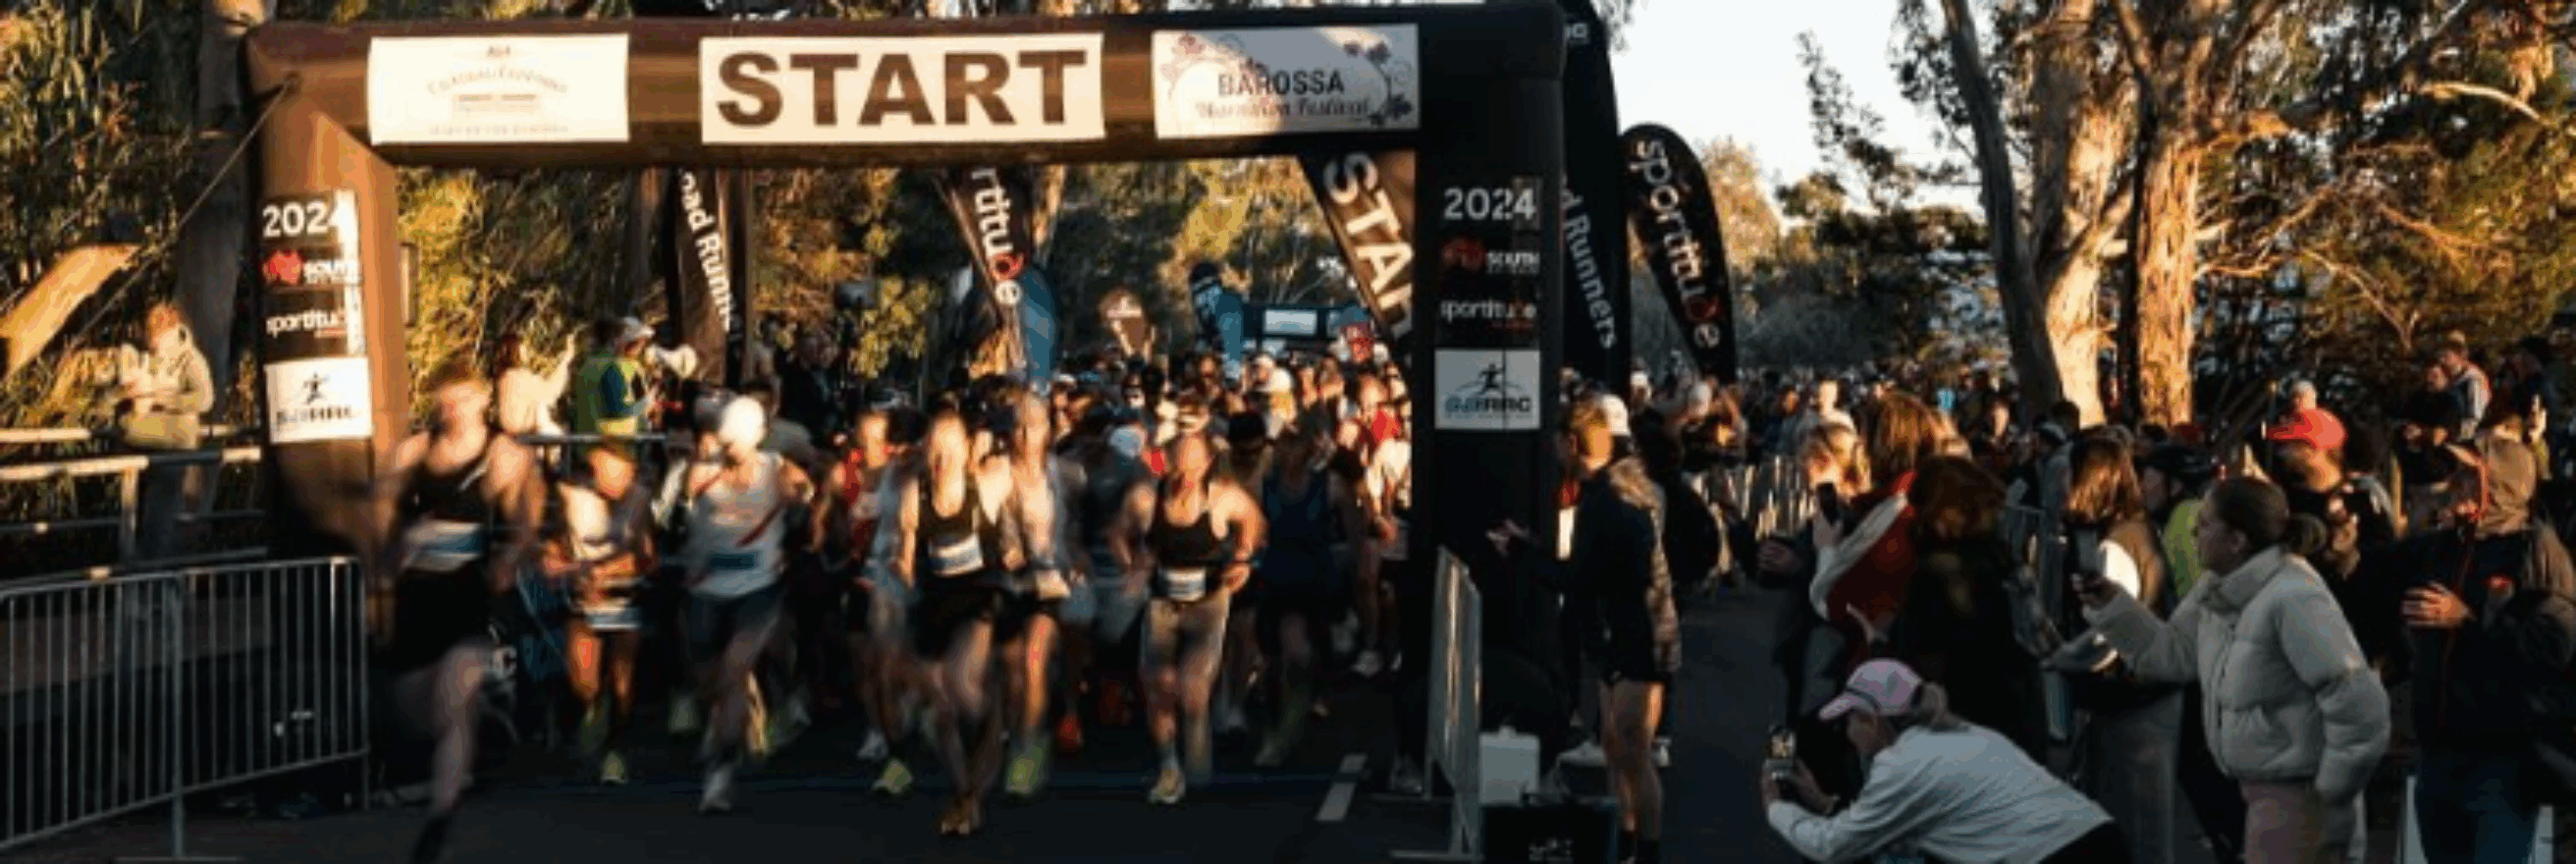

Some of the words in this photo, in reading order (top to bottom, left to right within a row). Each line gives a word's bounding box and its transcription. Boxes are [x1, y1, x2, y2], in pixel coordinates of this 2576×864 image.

[717, 49, 1089, 128] START
[1217, 69, 1346, 96] BAROSSA
[1443, 188, 1536, 221] 2024
[1565, 215, 1617, 350] Runners
